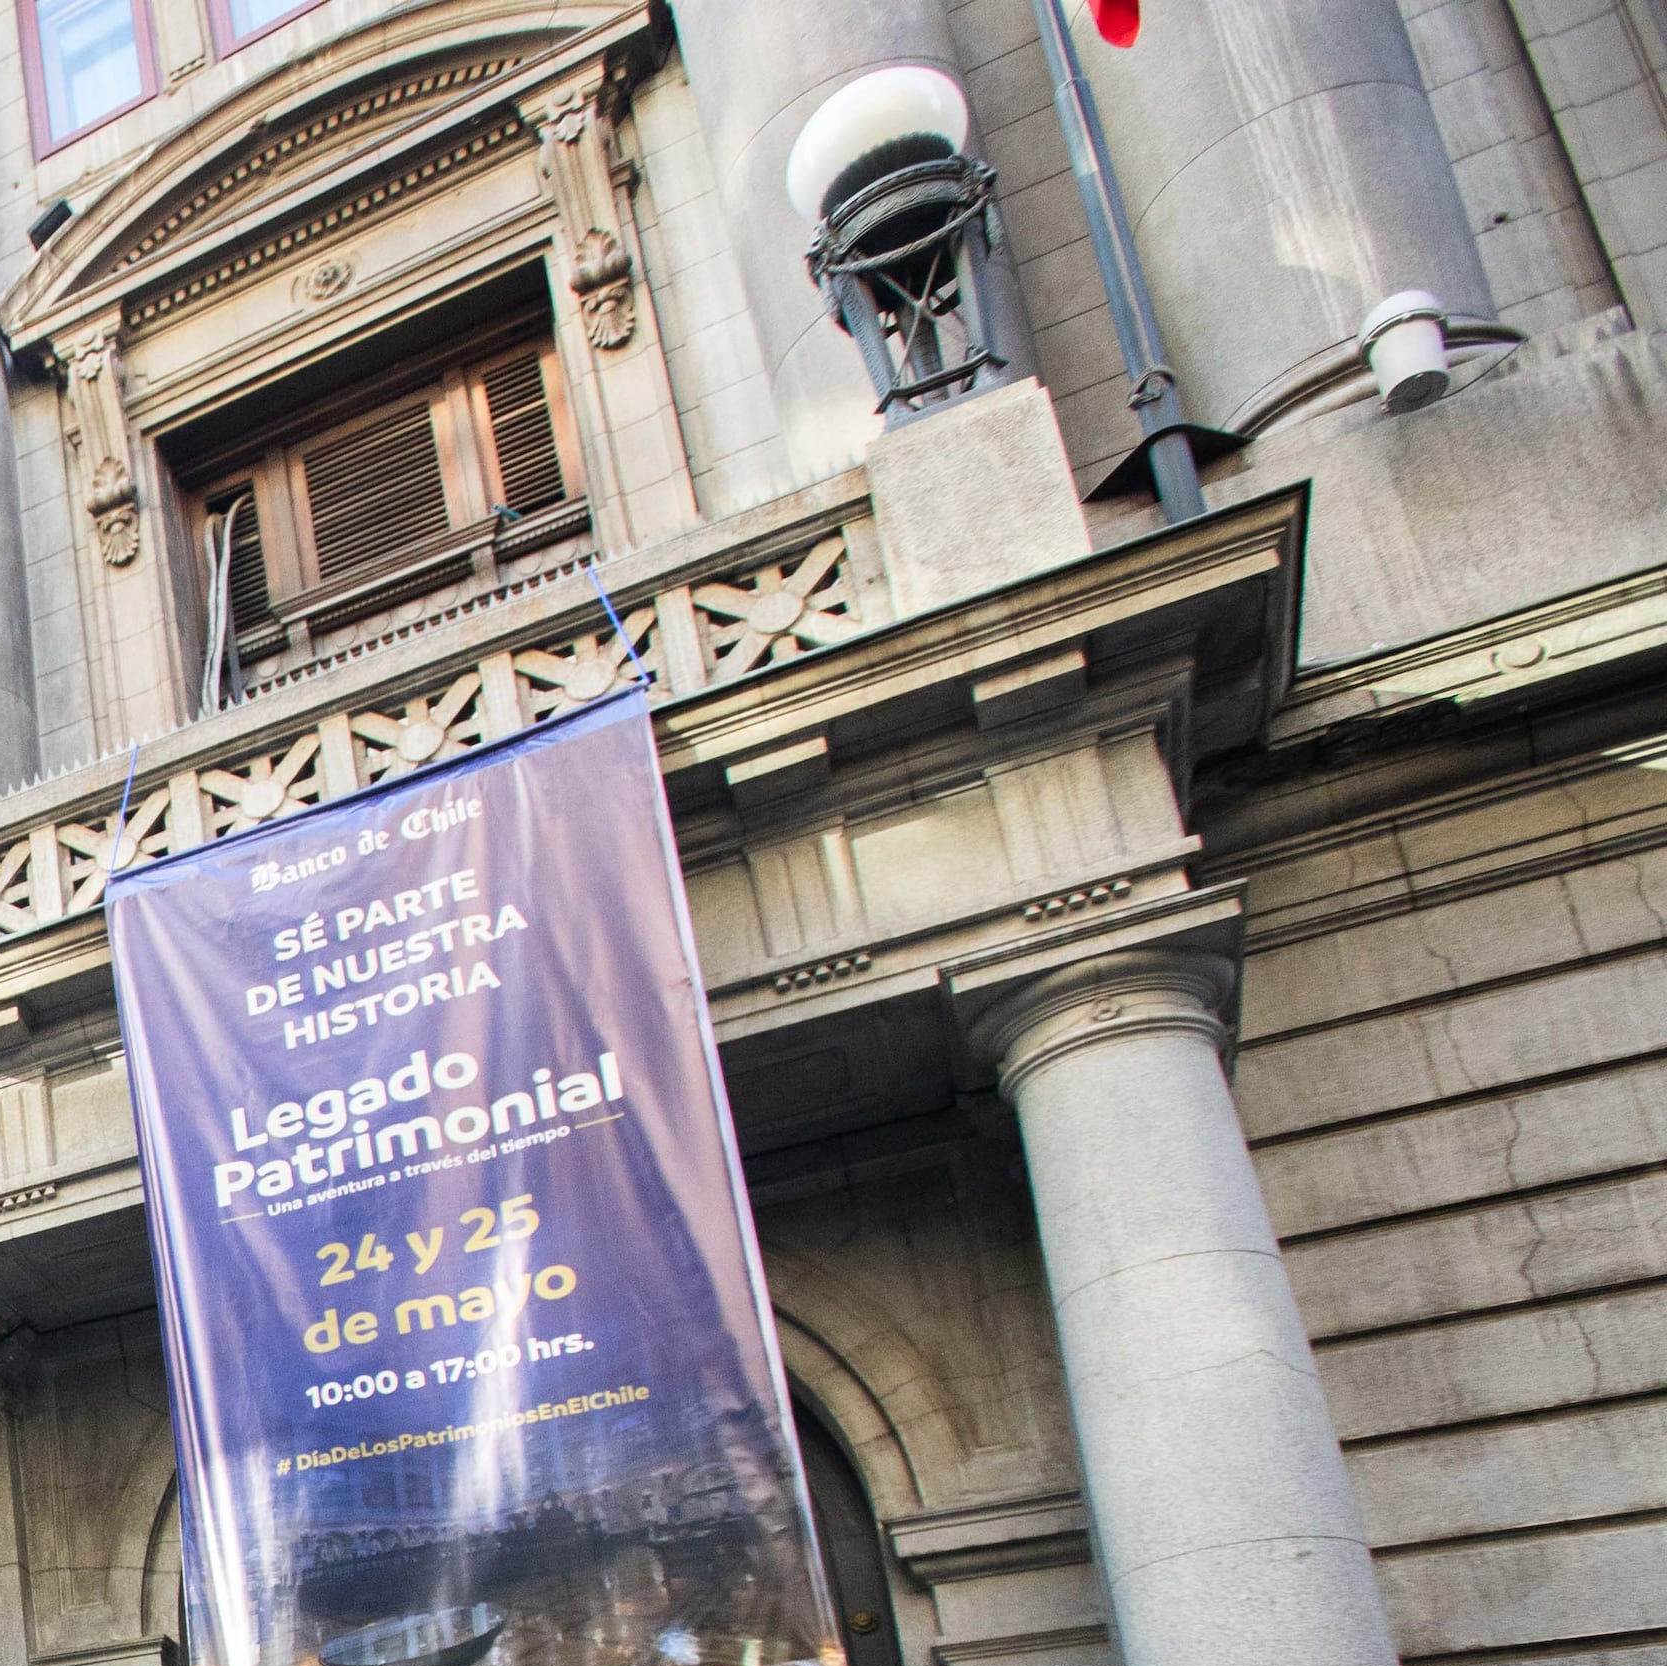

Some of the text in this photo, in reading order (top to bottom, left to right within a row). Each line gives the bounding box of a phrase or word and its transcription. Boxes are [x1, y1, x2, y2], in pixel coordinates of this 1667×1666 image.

[251, 797, 483, 894] Banco de Chile
[246, 906, 528, 1017] DE NUESTRA
[274, 869, 479, 961] SÉ PARTE
[284, 961, 500, 1050] HISTORIA
[214, 1053, 624, 1206] Patrimonial
[233, 1049, 478, 1152] Legado
[267, 1125, 571, 1217] Una aventura a través del tiempo
[316, 1193, 540, 1288] 24 y 25
[303, 1264, 577, 1355] de mayo
[306, 1330, 594, 1409] 10:00 a 17:00 hrs.
